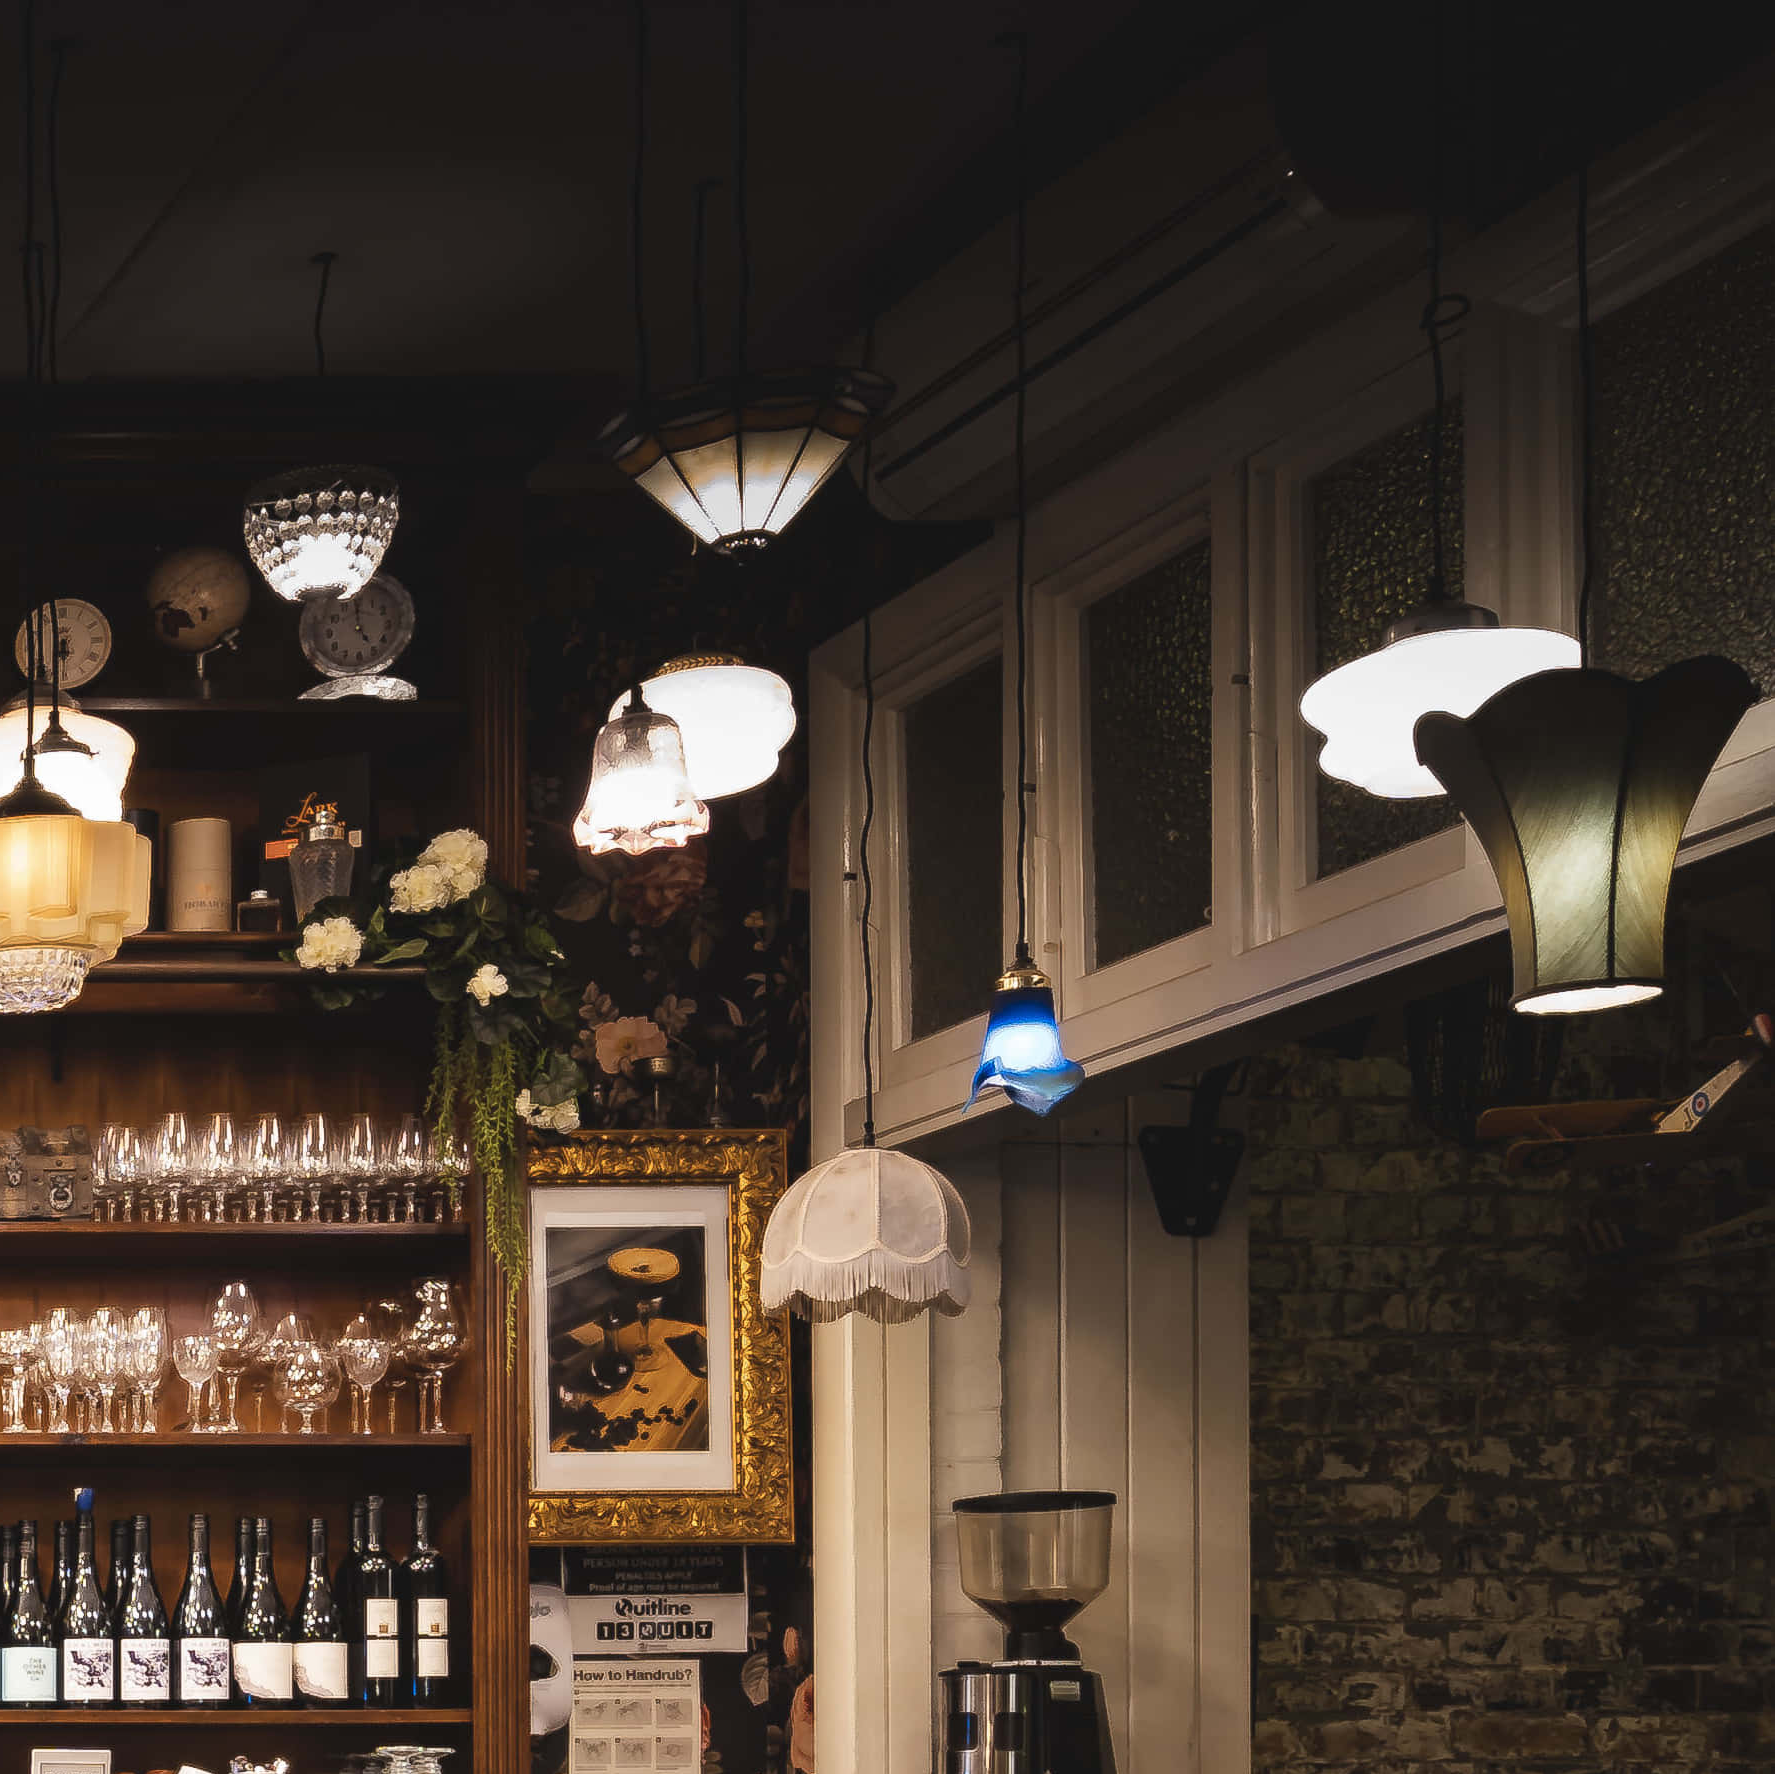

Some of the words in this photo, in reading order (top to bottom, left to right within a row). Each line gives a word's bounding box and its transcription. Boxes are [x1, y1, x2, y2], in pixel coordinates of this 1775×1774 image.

[615, 1599, 692, 1617] Quitline
[597, 1622, 635, 1640] 13
[639, 1621, 713, 1640] QUIT
[573, 1670, 604, 1681] How
[608, 1670, 622, 1681] to
[626, 1669, 692, 1681] Handrub?
